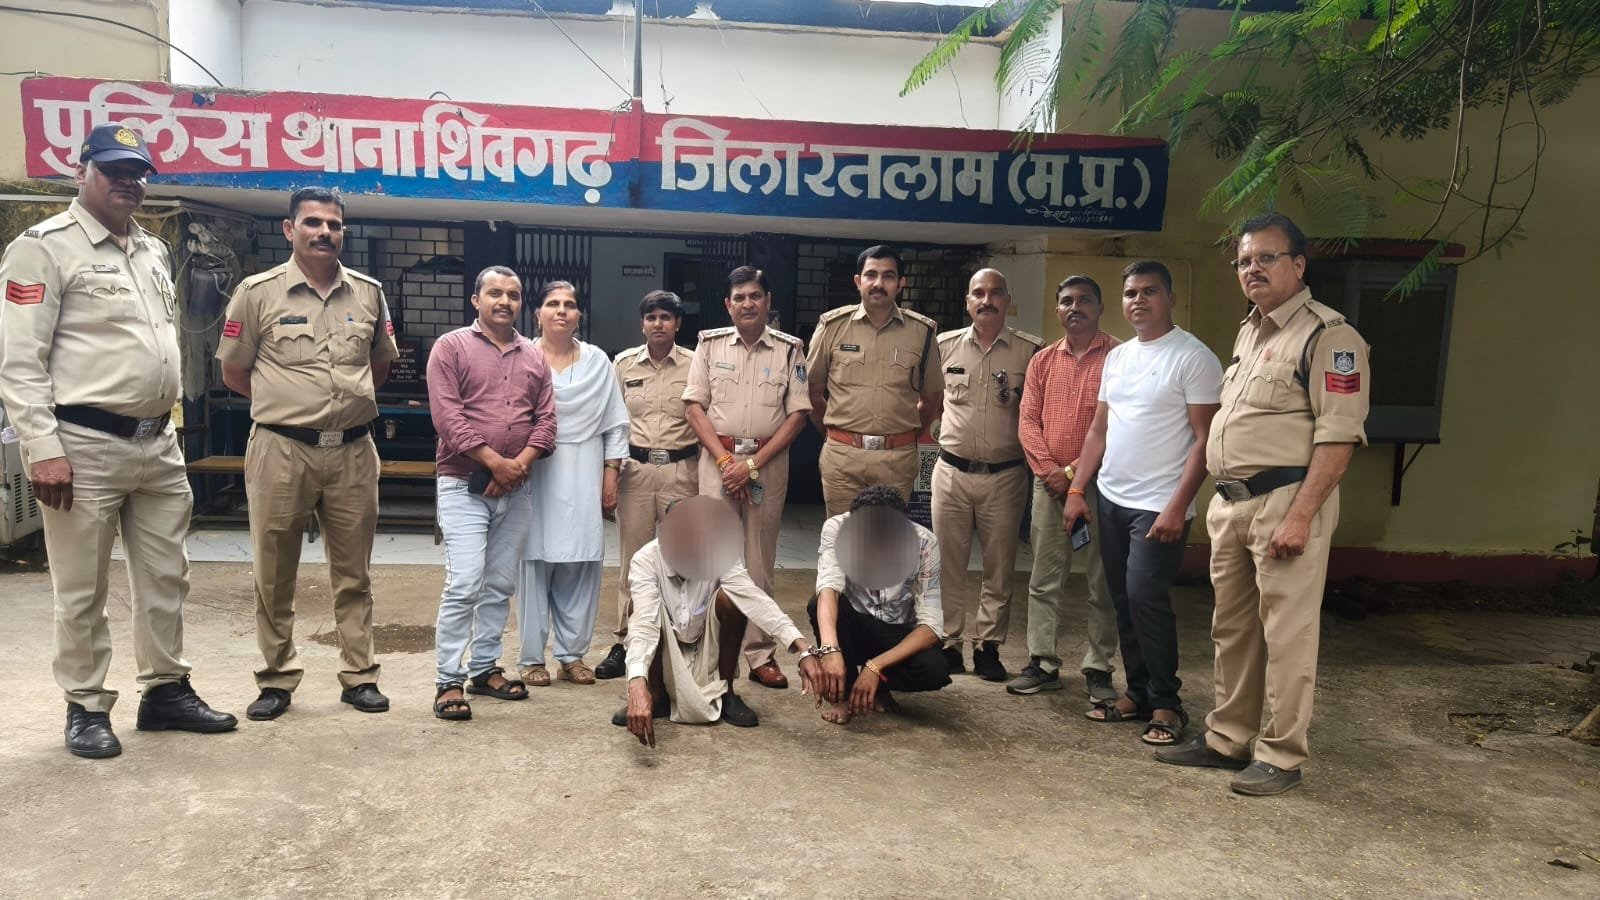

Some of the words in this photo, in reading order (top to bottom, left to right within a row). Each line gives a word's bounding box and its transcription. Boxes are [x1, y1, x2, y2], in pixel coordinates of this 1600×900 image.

[33, 81, 272, 178] पुलिस
[282, 113, 423, 178] थाना
[422, 102, 617, 205] शिवगढ़
[655, 118, 806, 197] जिला
[805, 143, 1000, 204] रतलाम
[1007, 152, 1152, 209] (म.प्र.)
